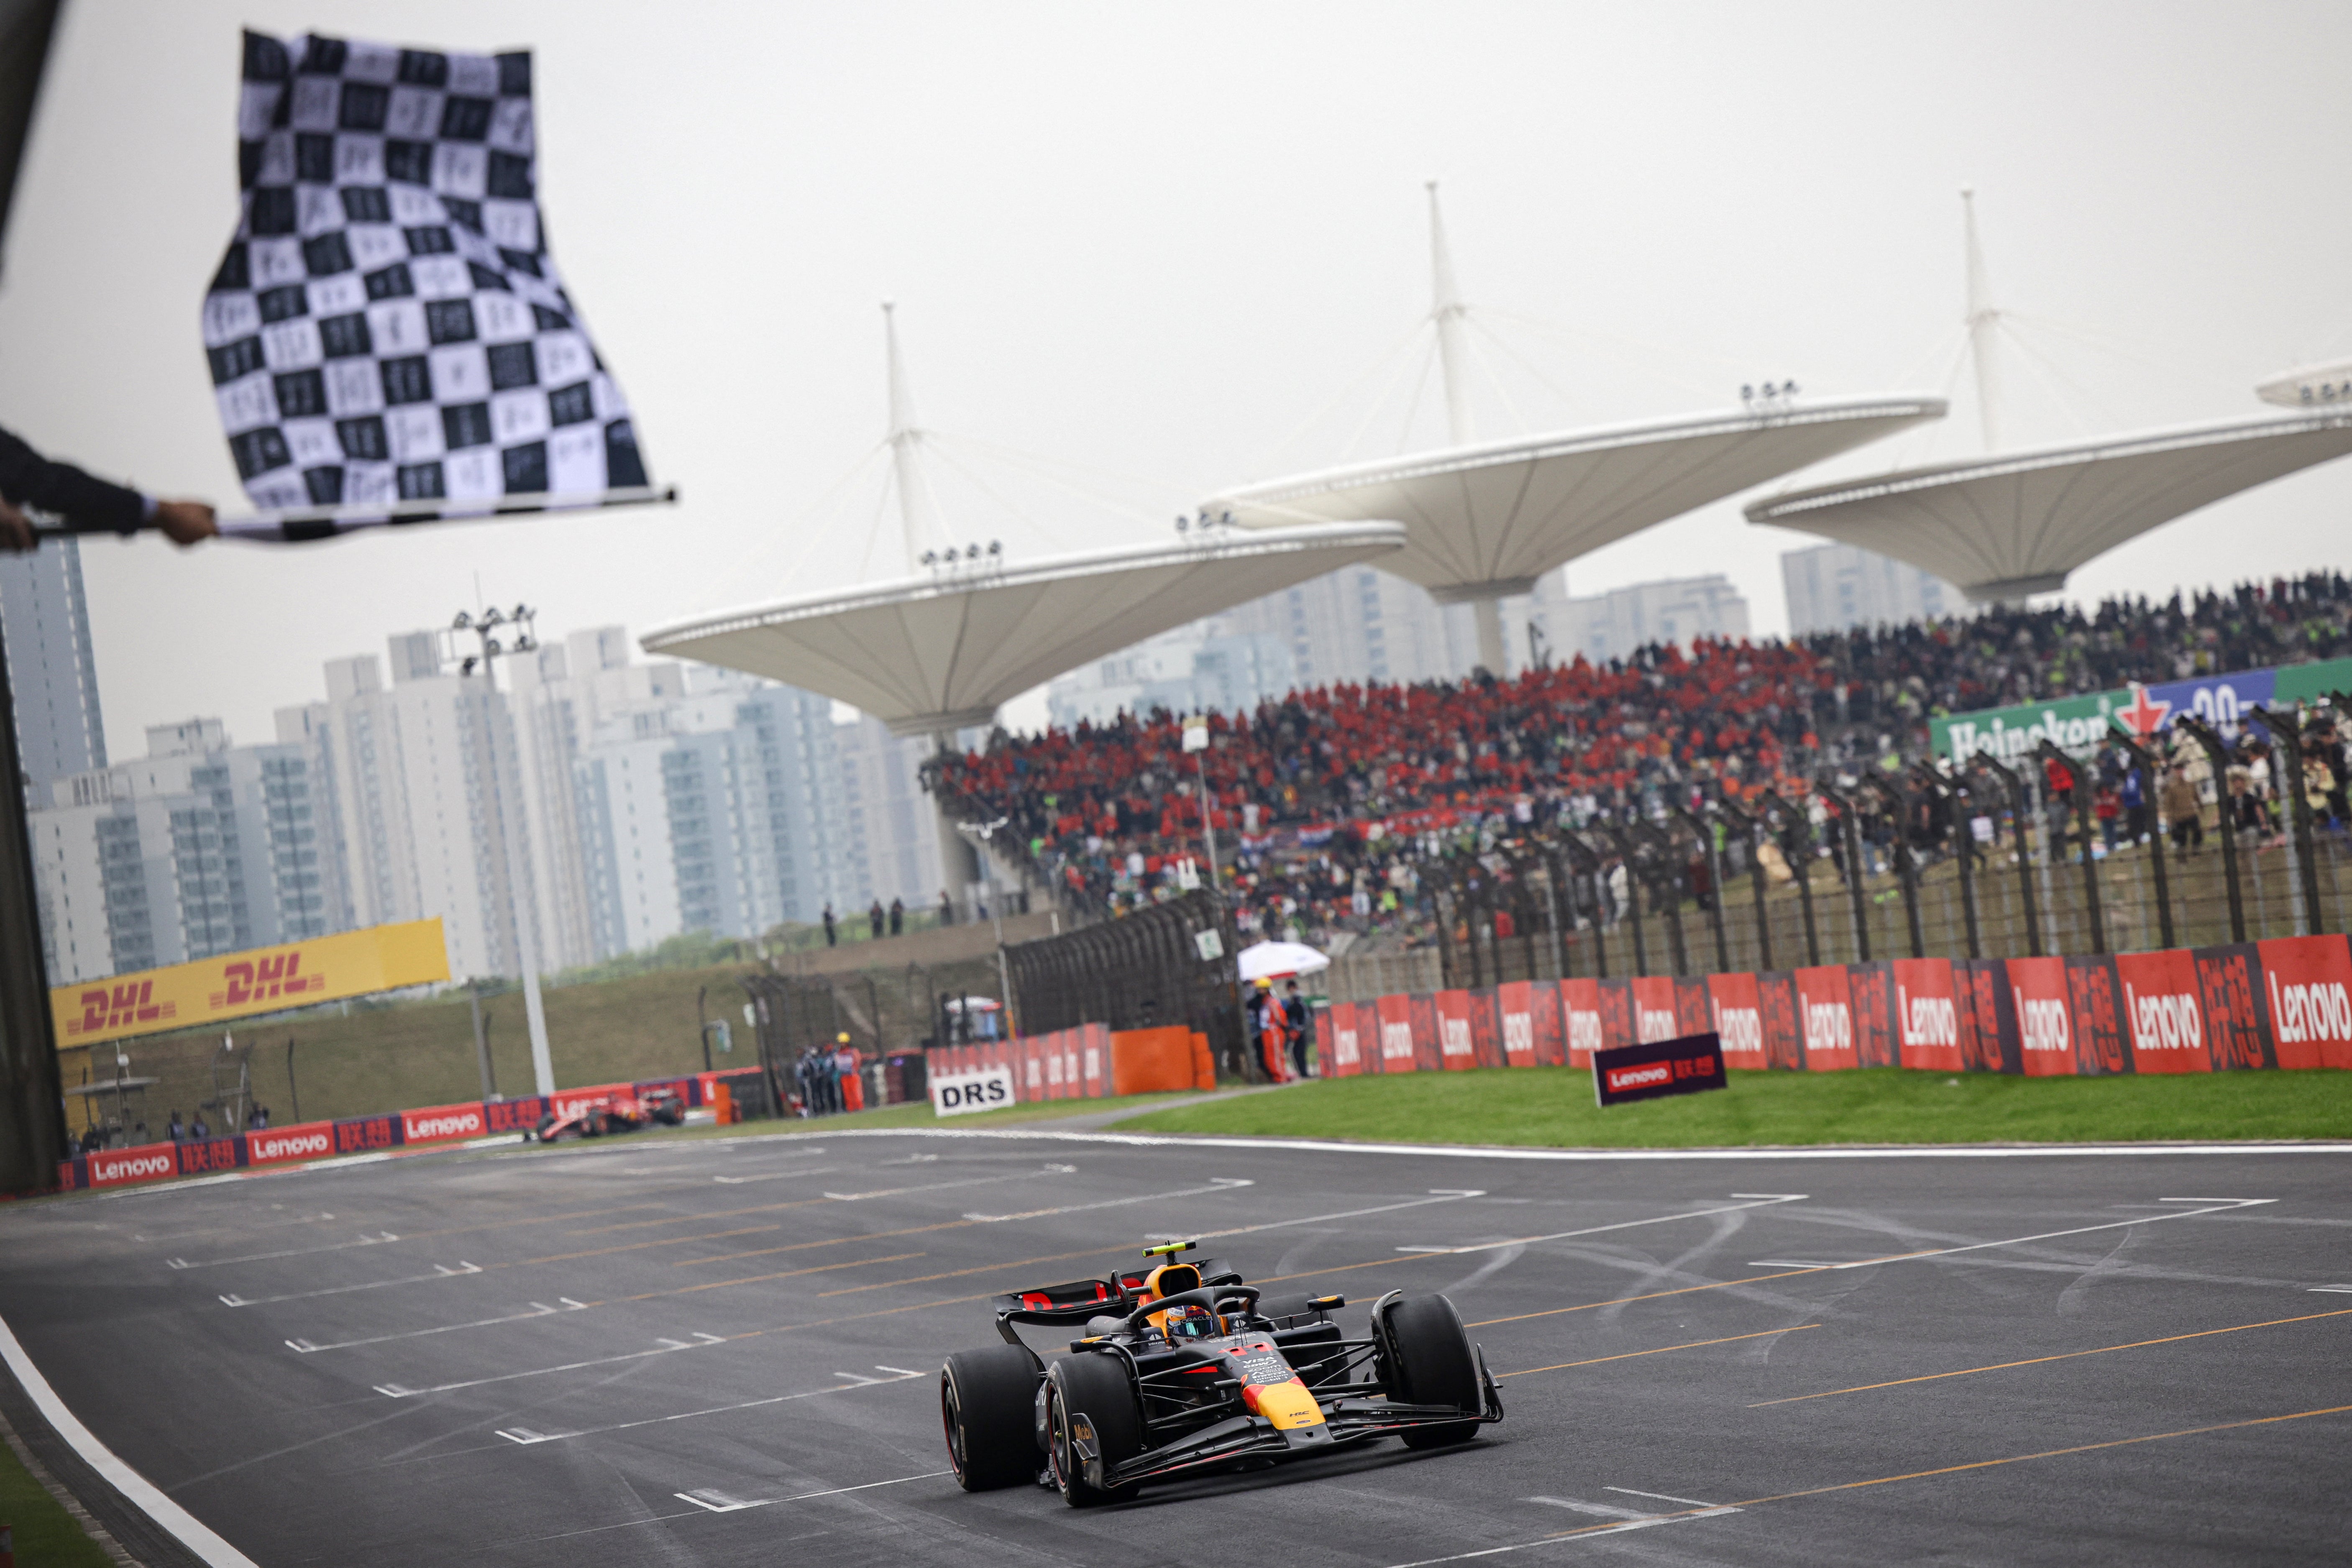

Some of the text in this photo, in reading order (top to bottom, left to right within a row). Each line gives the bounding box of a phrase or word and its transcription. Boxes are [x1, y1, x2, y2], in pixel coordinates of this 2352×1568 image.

[224, 952, 307, 1004] DHL
[81, 980, 159, 1032] DHL
[1899, 985, 1956, 1046] Lenovo
[2125, 982, 2201, 1050] Lenovo
[2269, 970, 2351, 1042] Lenovo
[1611, 1067, 1668, 1087] Lenovo
[942, 1080, 1005, 1108] DRS
[406, 1113, 479, 1138] Lenovo
[254, 1134, 328, 1159] Lenovo
[95, 1155, 170, 1181] Lenovo
[1217, 1342, 1274, 1356] 11
[1243, 1361, 1270, 1369] CDW
[1074, 1424, 1093, 1440] Mobil
